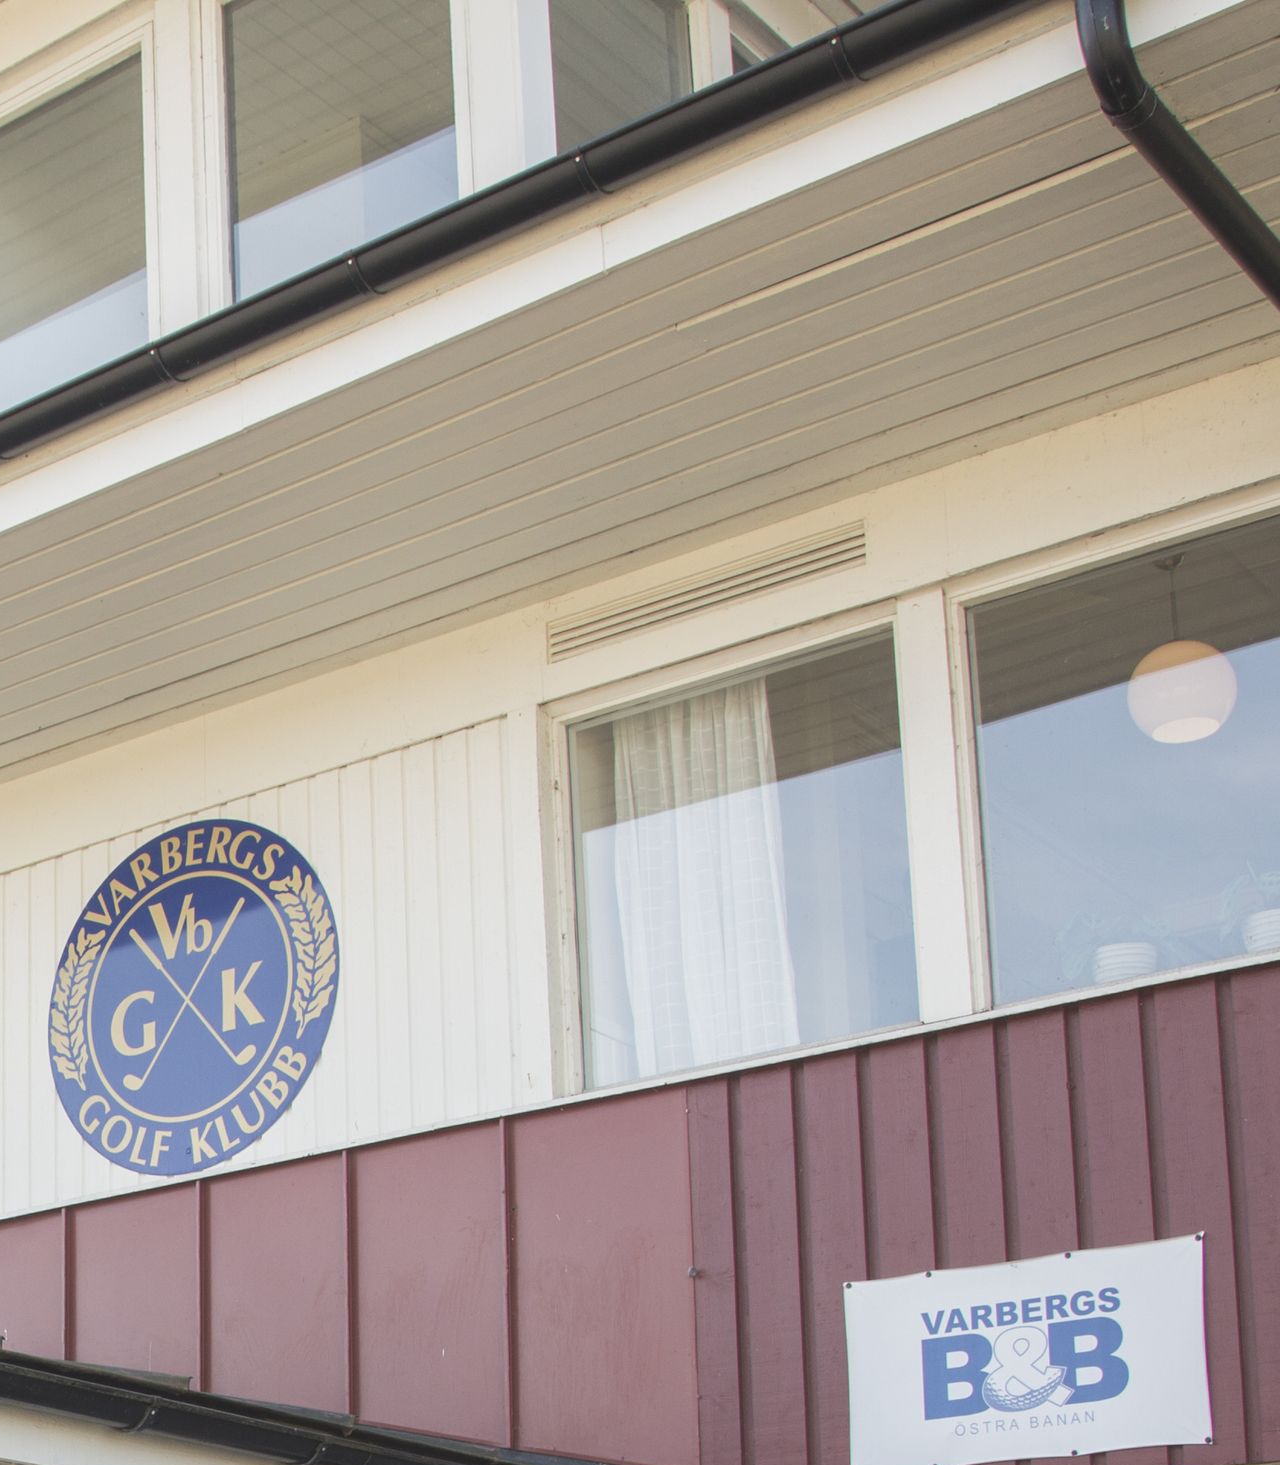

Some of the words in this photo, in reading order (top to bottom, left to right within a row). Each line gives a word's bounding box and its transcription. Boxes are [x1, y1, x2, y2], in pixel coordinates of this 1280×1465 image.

[84, 825, 286, 927] VARBERGS
[149, 893, 213, 960] Vb
[110, 990, 157, 1057] G
[221, 960, 266, 1033] K
[78, 1094, 173, 1168] GOLF
[190, 1044, 308, 1165] KLUBB
[921, 1286, 1121, 1336] VARBERGS
[921, 1316, 1131, 1421] B&B
[1029, 1410, 1096, 1429] BANAN
